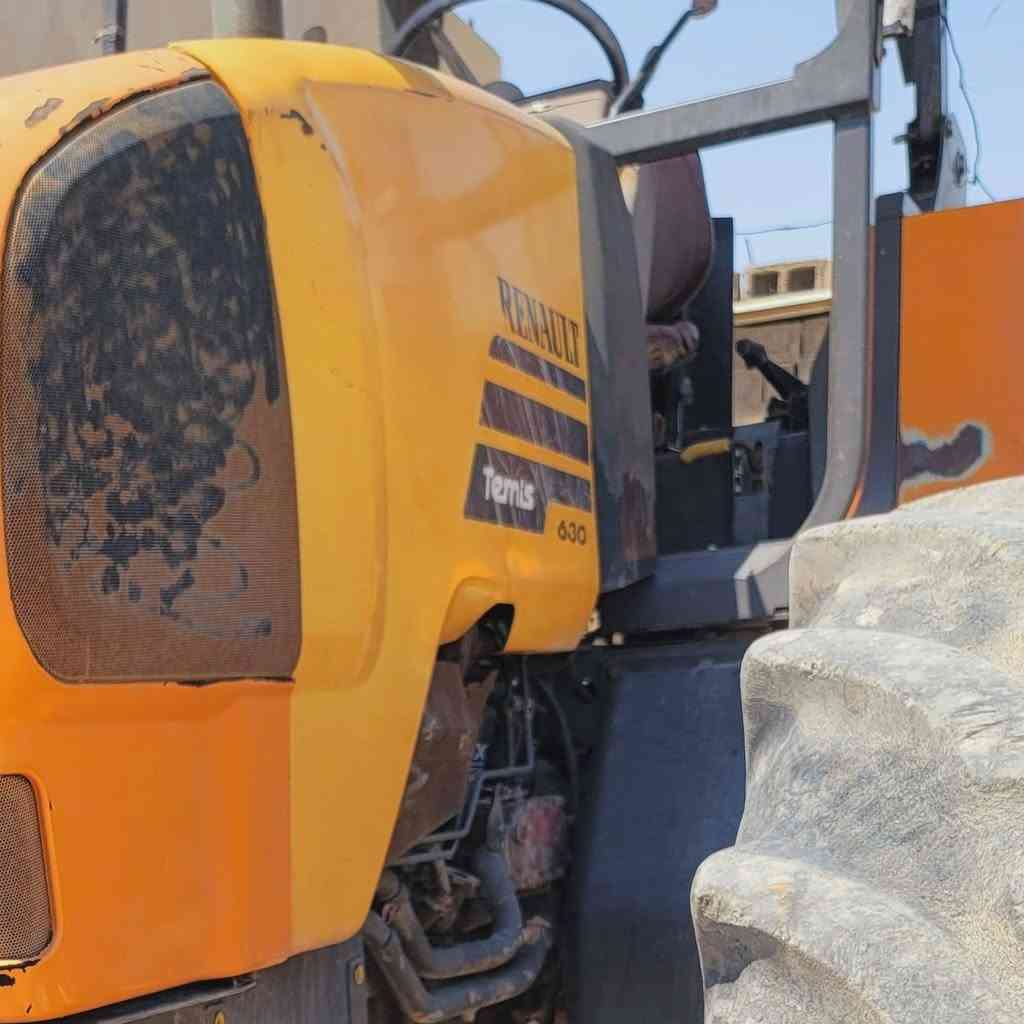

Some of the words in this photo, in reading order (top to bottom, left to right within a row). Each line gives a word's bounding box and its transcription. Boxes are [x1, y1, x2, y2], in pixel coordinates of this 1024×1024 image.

[496, 275, 579, 368] RENAULT
[482, 465, 535, 511] Temis
[557, 519, 586, 545] 630
